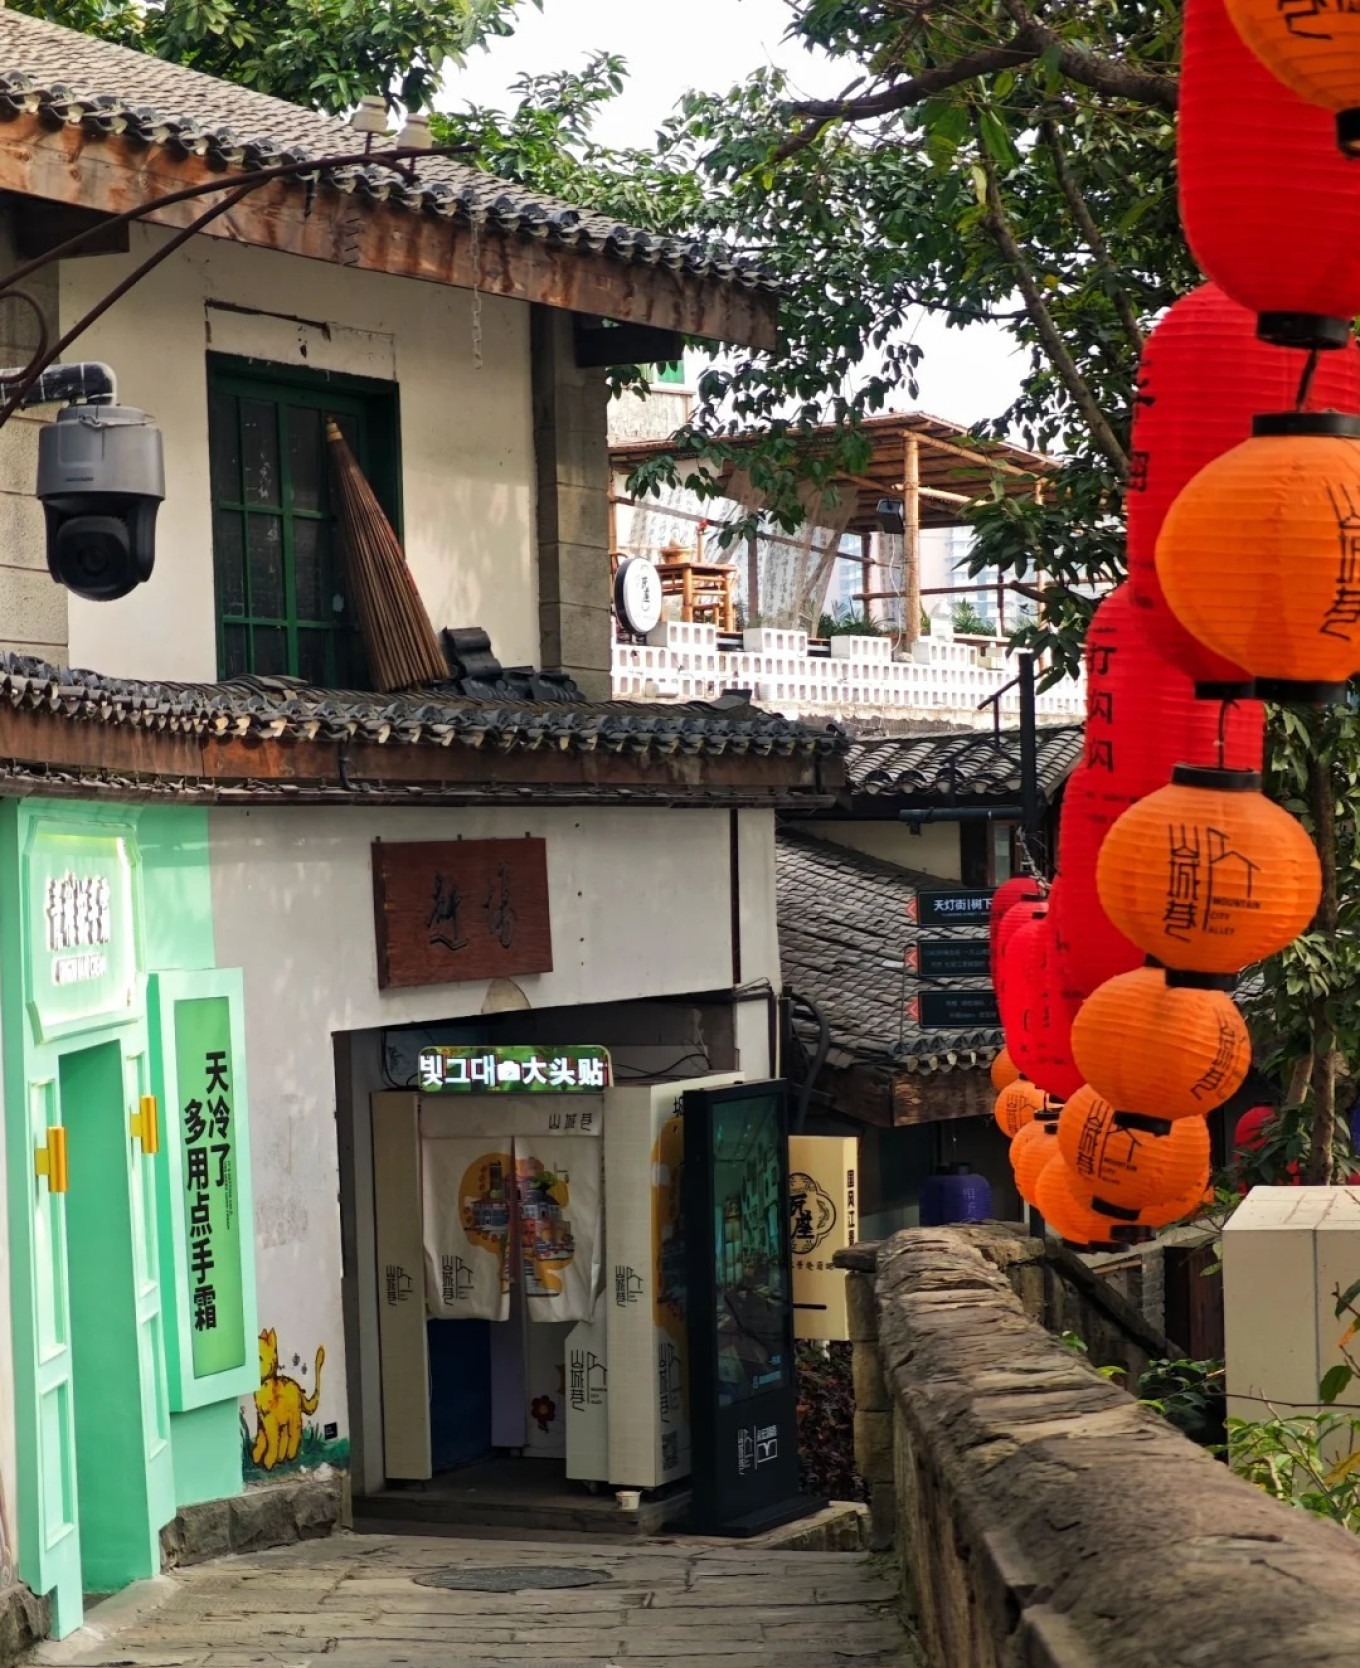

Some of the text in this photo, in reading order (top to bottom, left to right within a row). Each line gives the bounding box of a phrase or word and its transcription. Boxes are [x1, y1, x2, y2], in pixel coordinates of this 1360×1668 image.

[522, 1056, 604, 1086] 大头贴
[205, 1051, 232, 1187] 天冷了
[549, 1112, 593, 1132] 山城巷
[184, 1098, 218, 1332] 多用点手霜
